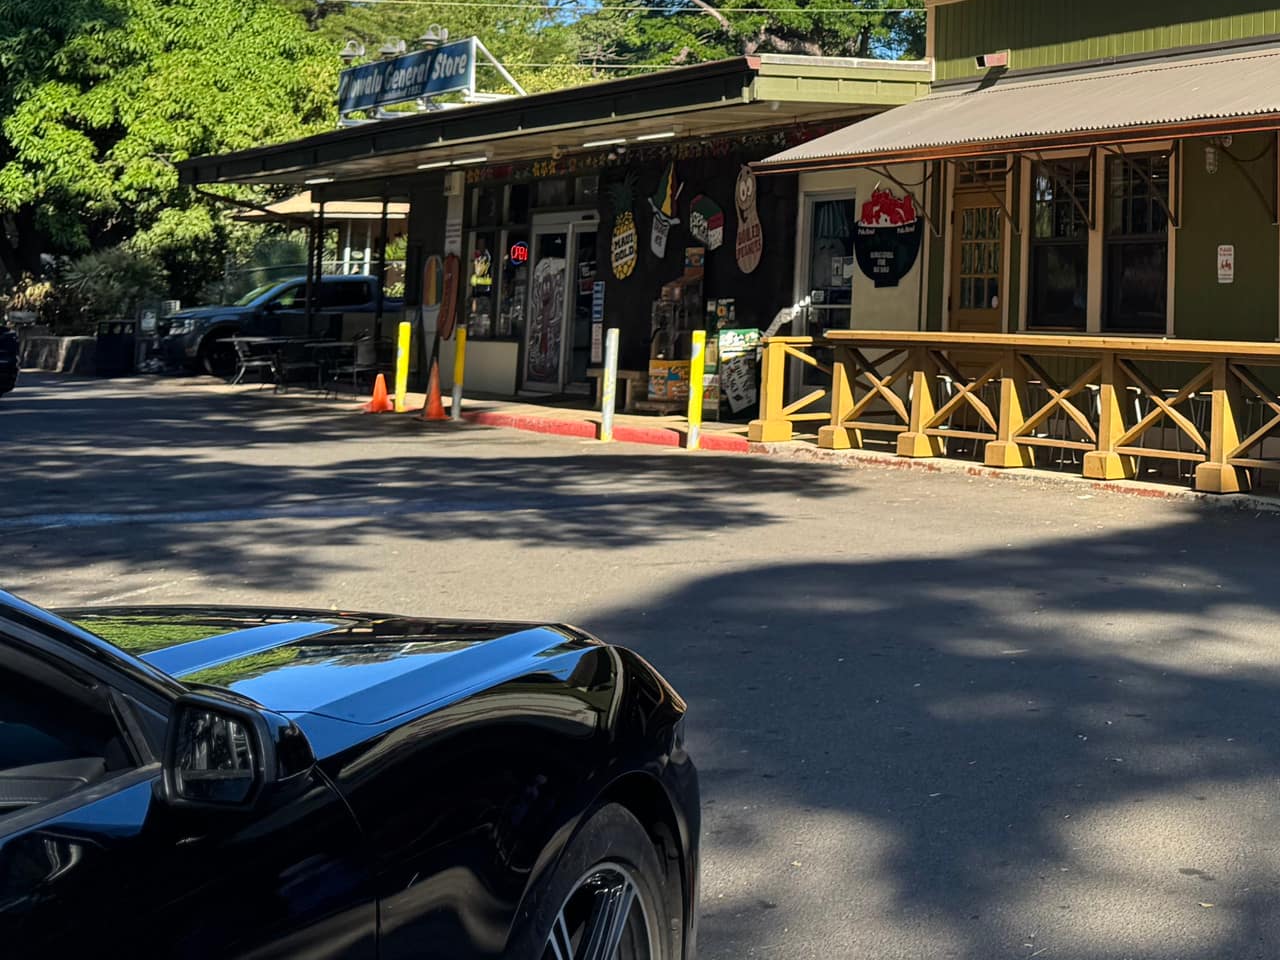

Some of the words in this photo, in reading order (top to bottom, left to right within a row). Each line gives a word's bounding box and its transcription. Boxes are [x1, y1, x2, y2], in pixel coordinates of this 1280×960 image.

[384, 55, 431, 90] General
[431, 52, 467, 80] Store
[614, 232, 633, 250] MAUI
